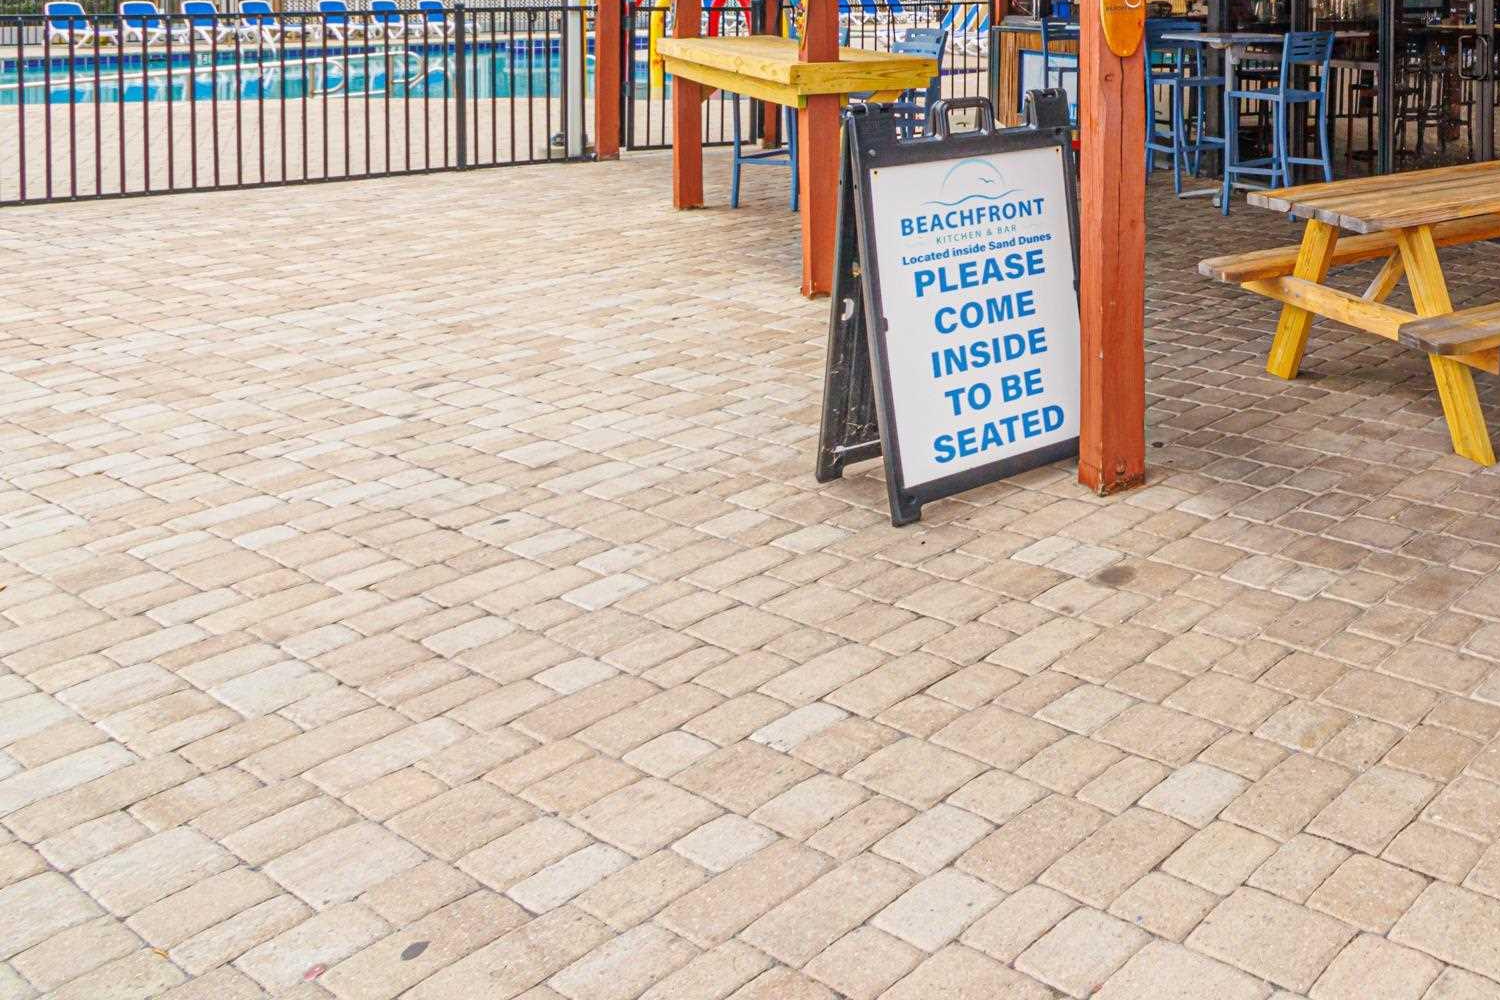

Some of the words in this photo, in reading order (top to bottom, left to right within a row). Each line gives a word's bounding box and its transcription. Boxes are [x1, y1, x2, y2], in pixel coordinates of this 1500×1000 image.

[901, 198, 1045, 236] BEACHFRONT
[936, 230, 982, 245] KITCHEN
[986, 228, 993, 236] &
[997, 224, 1017, 234] BAR
[902, 249, 950, 265] Located
[952, 243, 986, 257] inside
[989, 238, 1016, 251] Sand
[1018, 233, 1052, 246] Dunes
[914, 249, 1046, 298] PLEASE
[934, 290, 1036, 334] COME
[931, 327, 1048, 378] INSIDE
[944, 382, 992, 416] TO
[1001, 368, 1044, 403] BE
[933, 405, 1065, 464] SEATED
